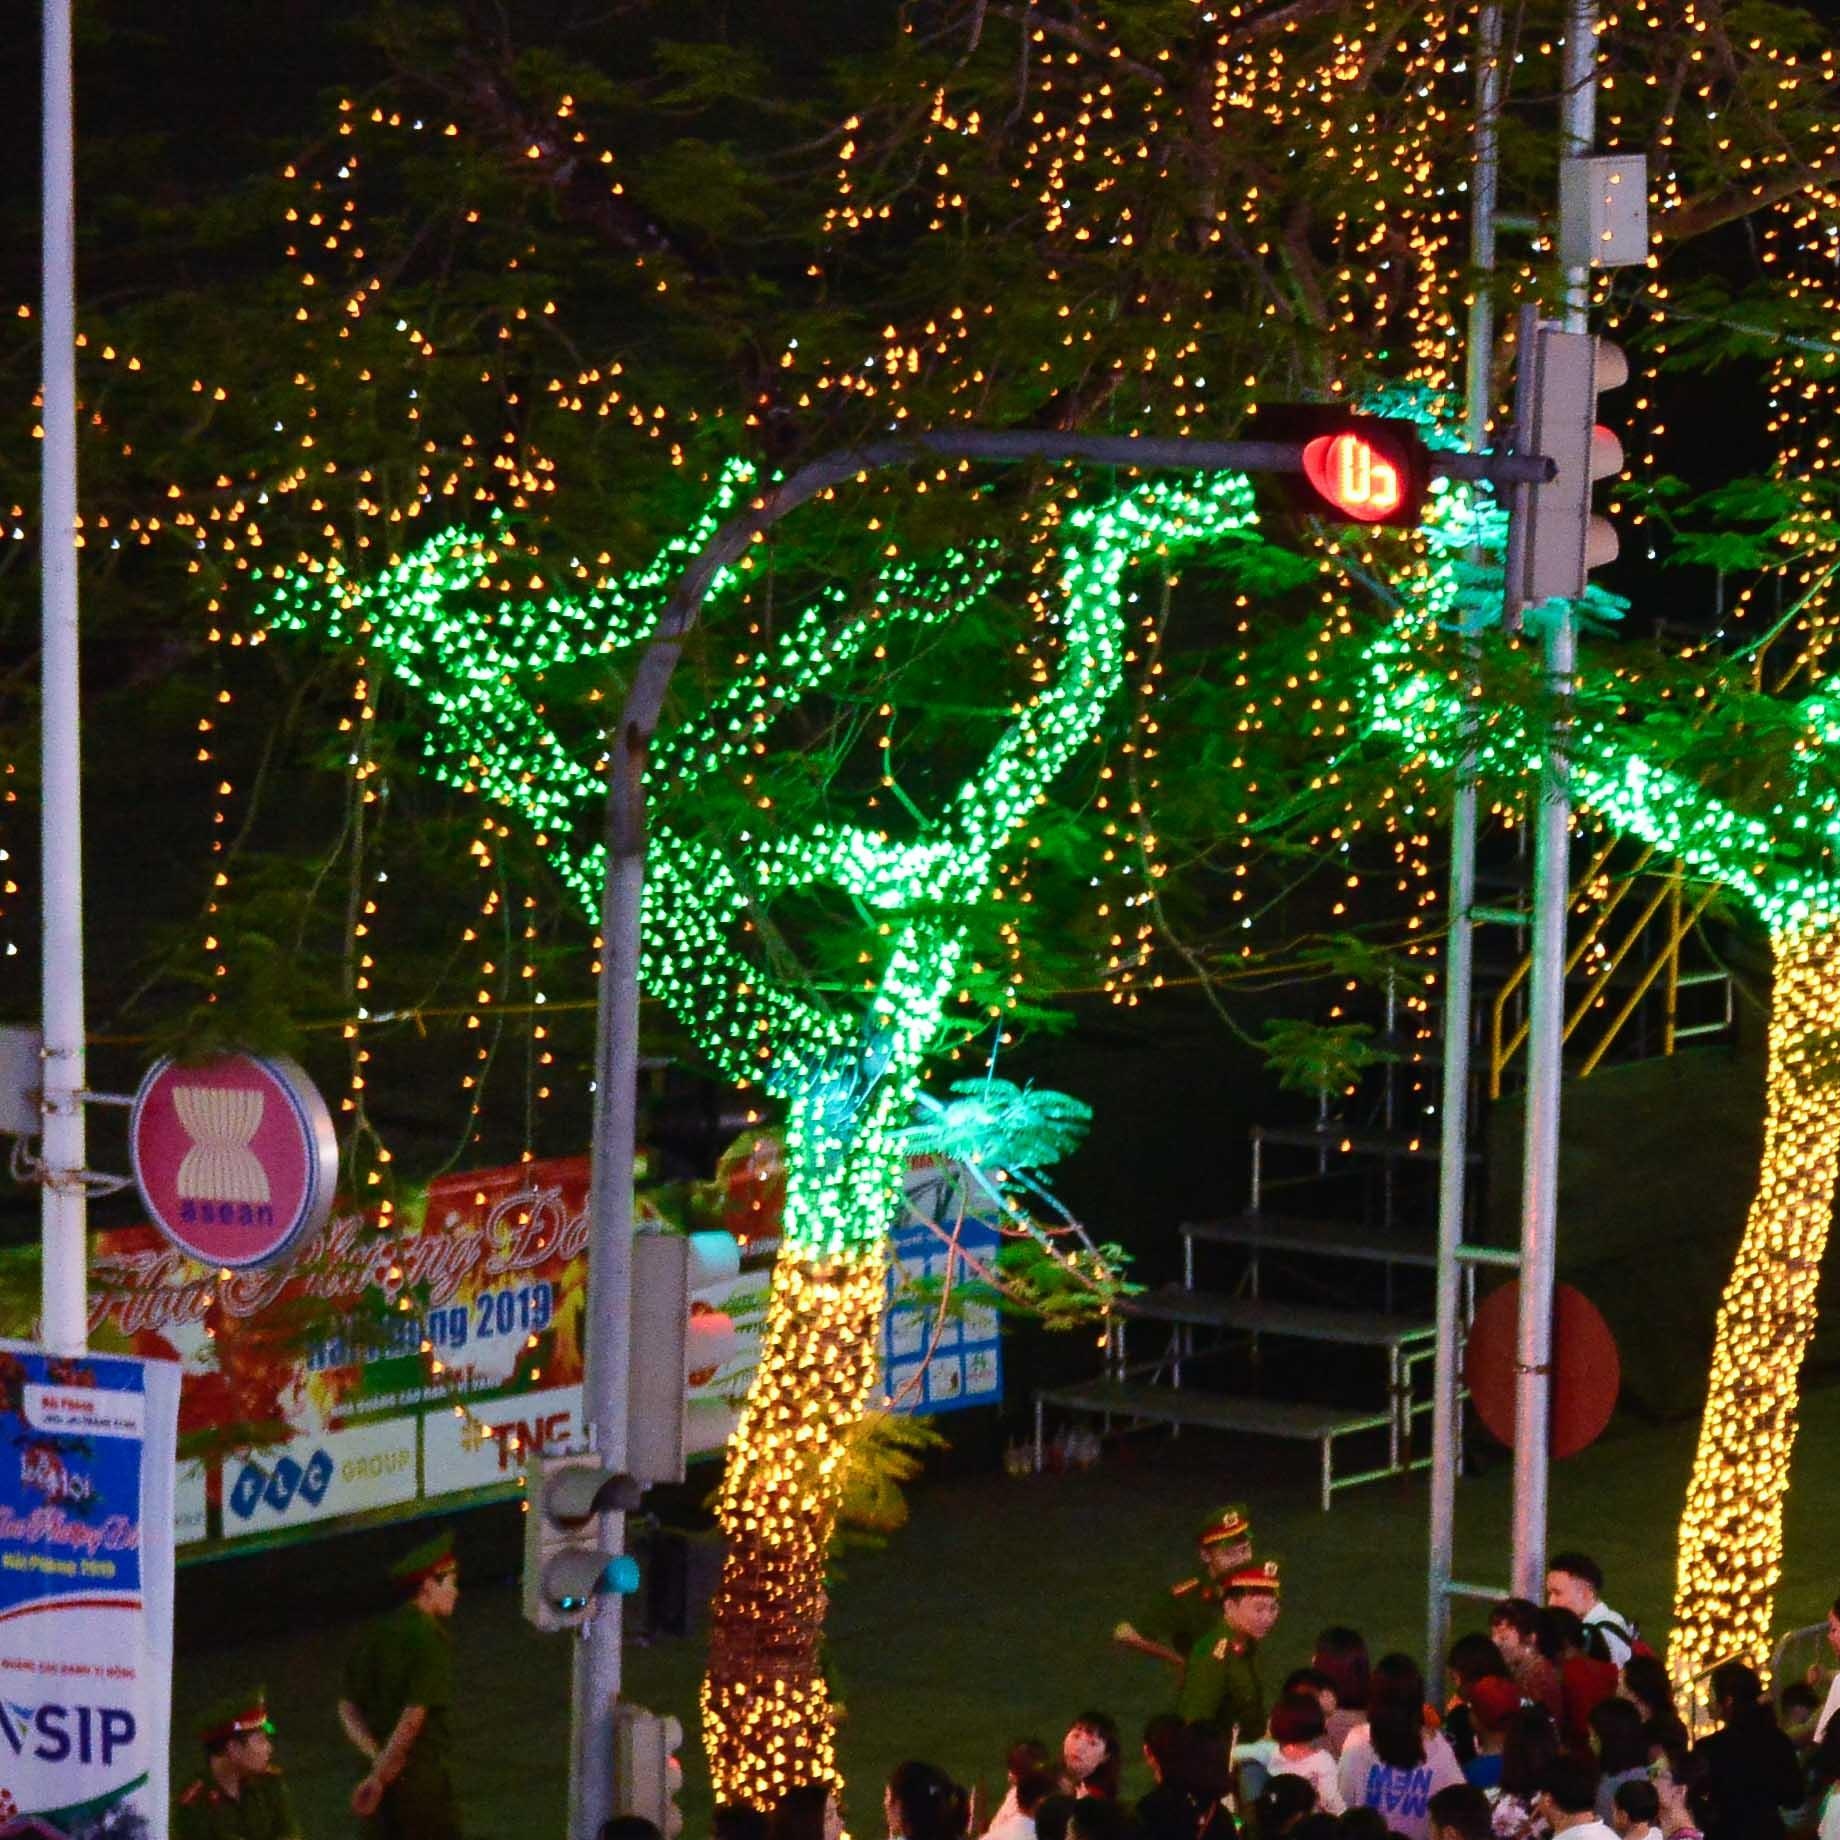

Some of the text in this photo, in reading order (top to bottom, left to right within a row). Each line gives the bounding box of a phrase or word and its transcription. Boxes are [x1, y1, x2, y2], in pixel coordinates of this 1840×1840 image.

[179, 1198, 273, 1227] asean
[476, 1283, 552, 1338] 2019
[341, 1450, 410, 1484] GROUP
